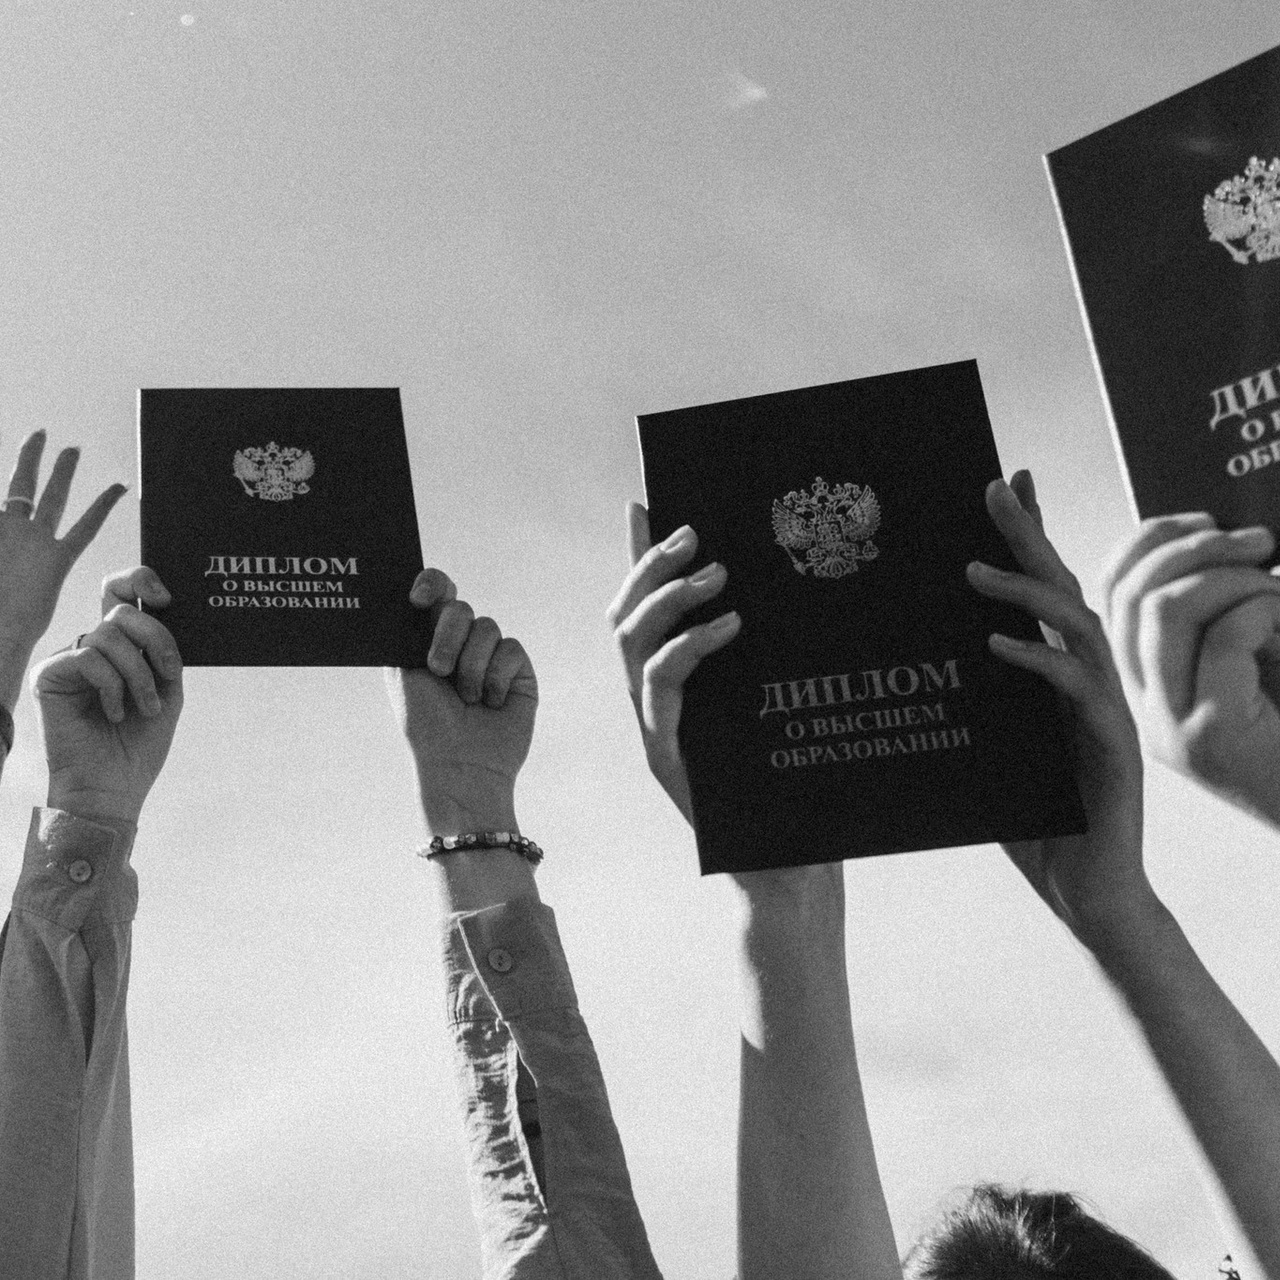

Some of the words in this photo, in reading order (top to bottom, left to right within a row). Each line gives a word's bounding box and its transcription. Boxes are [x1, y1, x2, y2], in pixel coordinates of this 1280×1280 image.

[1210, 364, 1280, 431] ДИ
[1241, 419, 1265, 440] О
[204, 556, 360, 577] ДИПЛОМ
[223, 580, 238, 591] О
[243, 580, 343, 592] ВЫСШЕМ
[208, 595, 360, 608] ОБРАЗОВАНИИ
[760, 659, 963, 719] ДИПЛОМ
[785, 721, 805, 740] О
[812, 702, 945, 738] ВЫСШЕМ
[771, 727, 970, 769] ОБРАЗОВАНИИ
